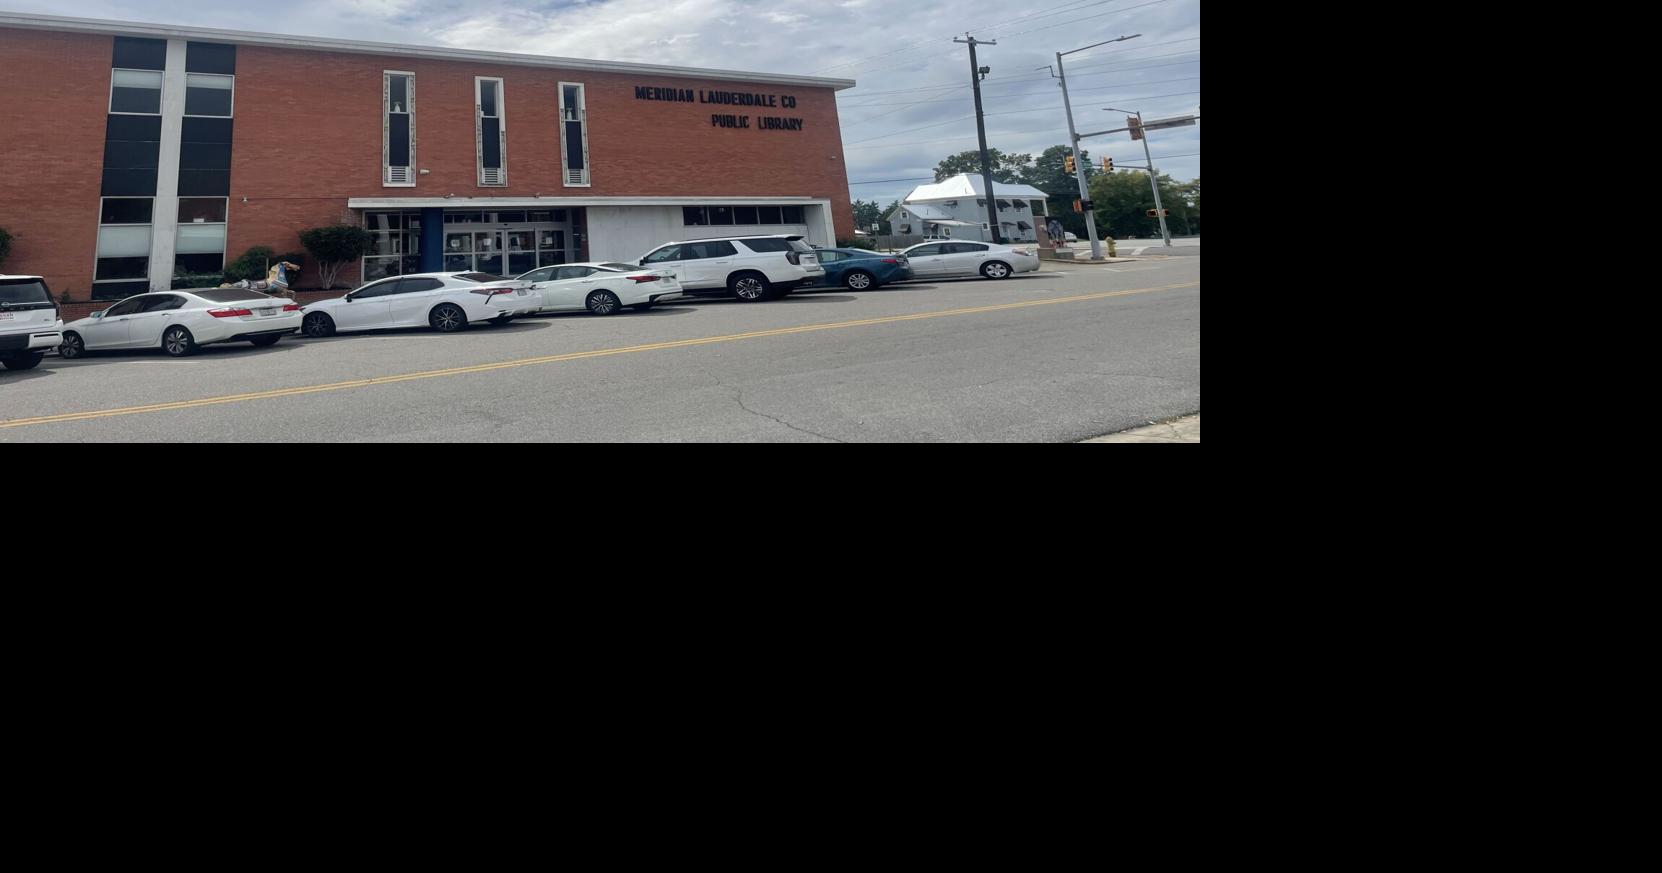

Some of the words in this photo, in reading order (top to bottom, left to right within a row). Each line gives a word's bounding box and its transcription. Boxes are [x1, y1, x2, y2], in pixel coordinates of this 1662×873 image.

[635, 86, 695, 103] MERIDIAN
[700, 90, 777, 108] LAUDERDALE
[781, 95, 796, 109] CO
[712, 114, 750, 129] PUBLIC
[757, 116, 803, 131] LIBRARY
